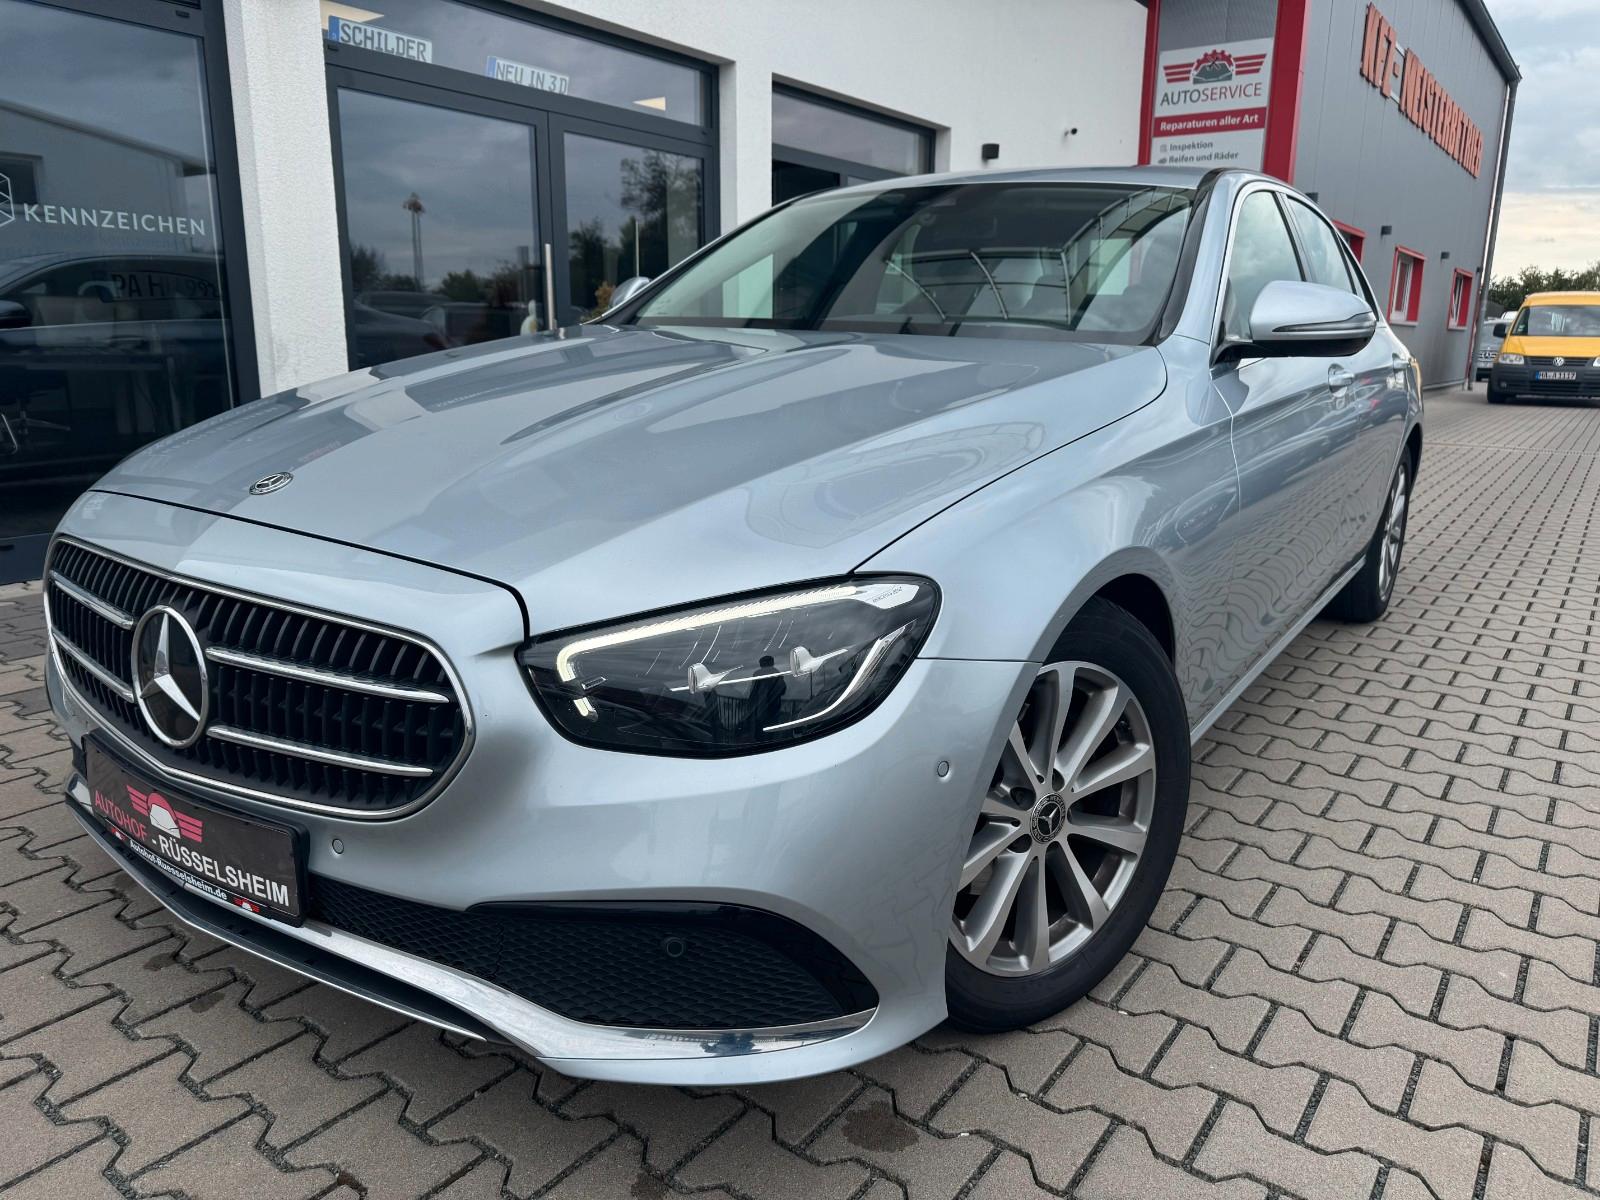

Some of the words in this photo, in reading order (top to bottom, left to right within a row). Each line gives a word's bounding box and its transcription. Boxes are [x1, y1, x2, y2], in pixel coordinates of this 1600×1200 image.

[340, 23, 426, 61] SCHILDER
[496, 61, 524, 84] NEU
[528, 70, 545, 89] IN
[1160, 82, 1263, 107] AUTOSERVICE
[1160, 118, 1218, 132] Reparaturen
[1218, 115, 1241, 126] aller
[1242, 114, 1259, 124] Art
[1168, 154, 1194, 164] Reifen
[1195, 152, 1213, 162] und
[1214, 151, 1240, 161] Räder
[1169, 141, 1214, 152] Inspektion
[23, 202, 206, 236] KENNZEICHEN
[94, 790, 148, 841] AUTOHOF
[158, 834, 289, 907] RÜSSELSHEIM
